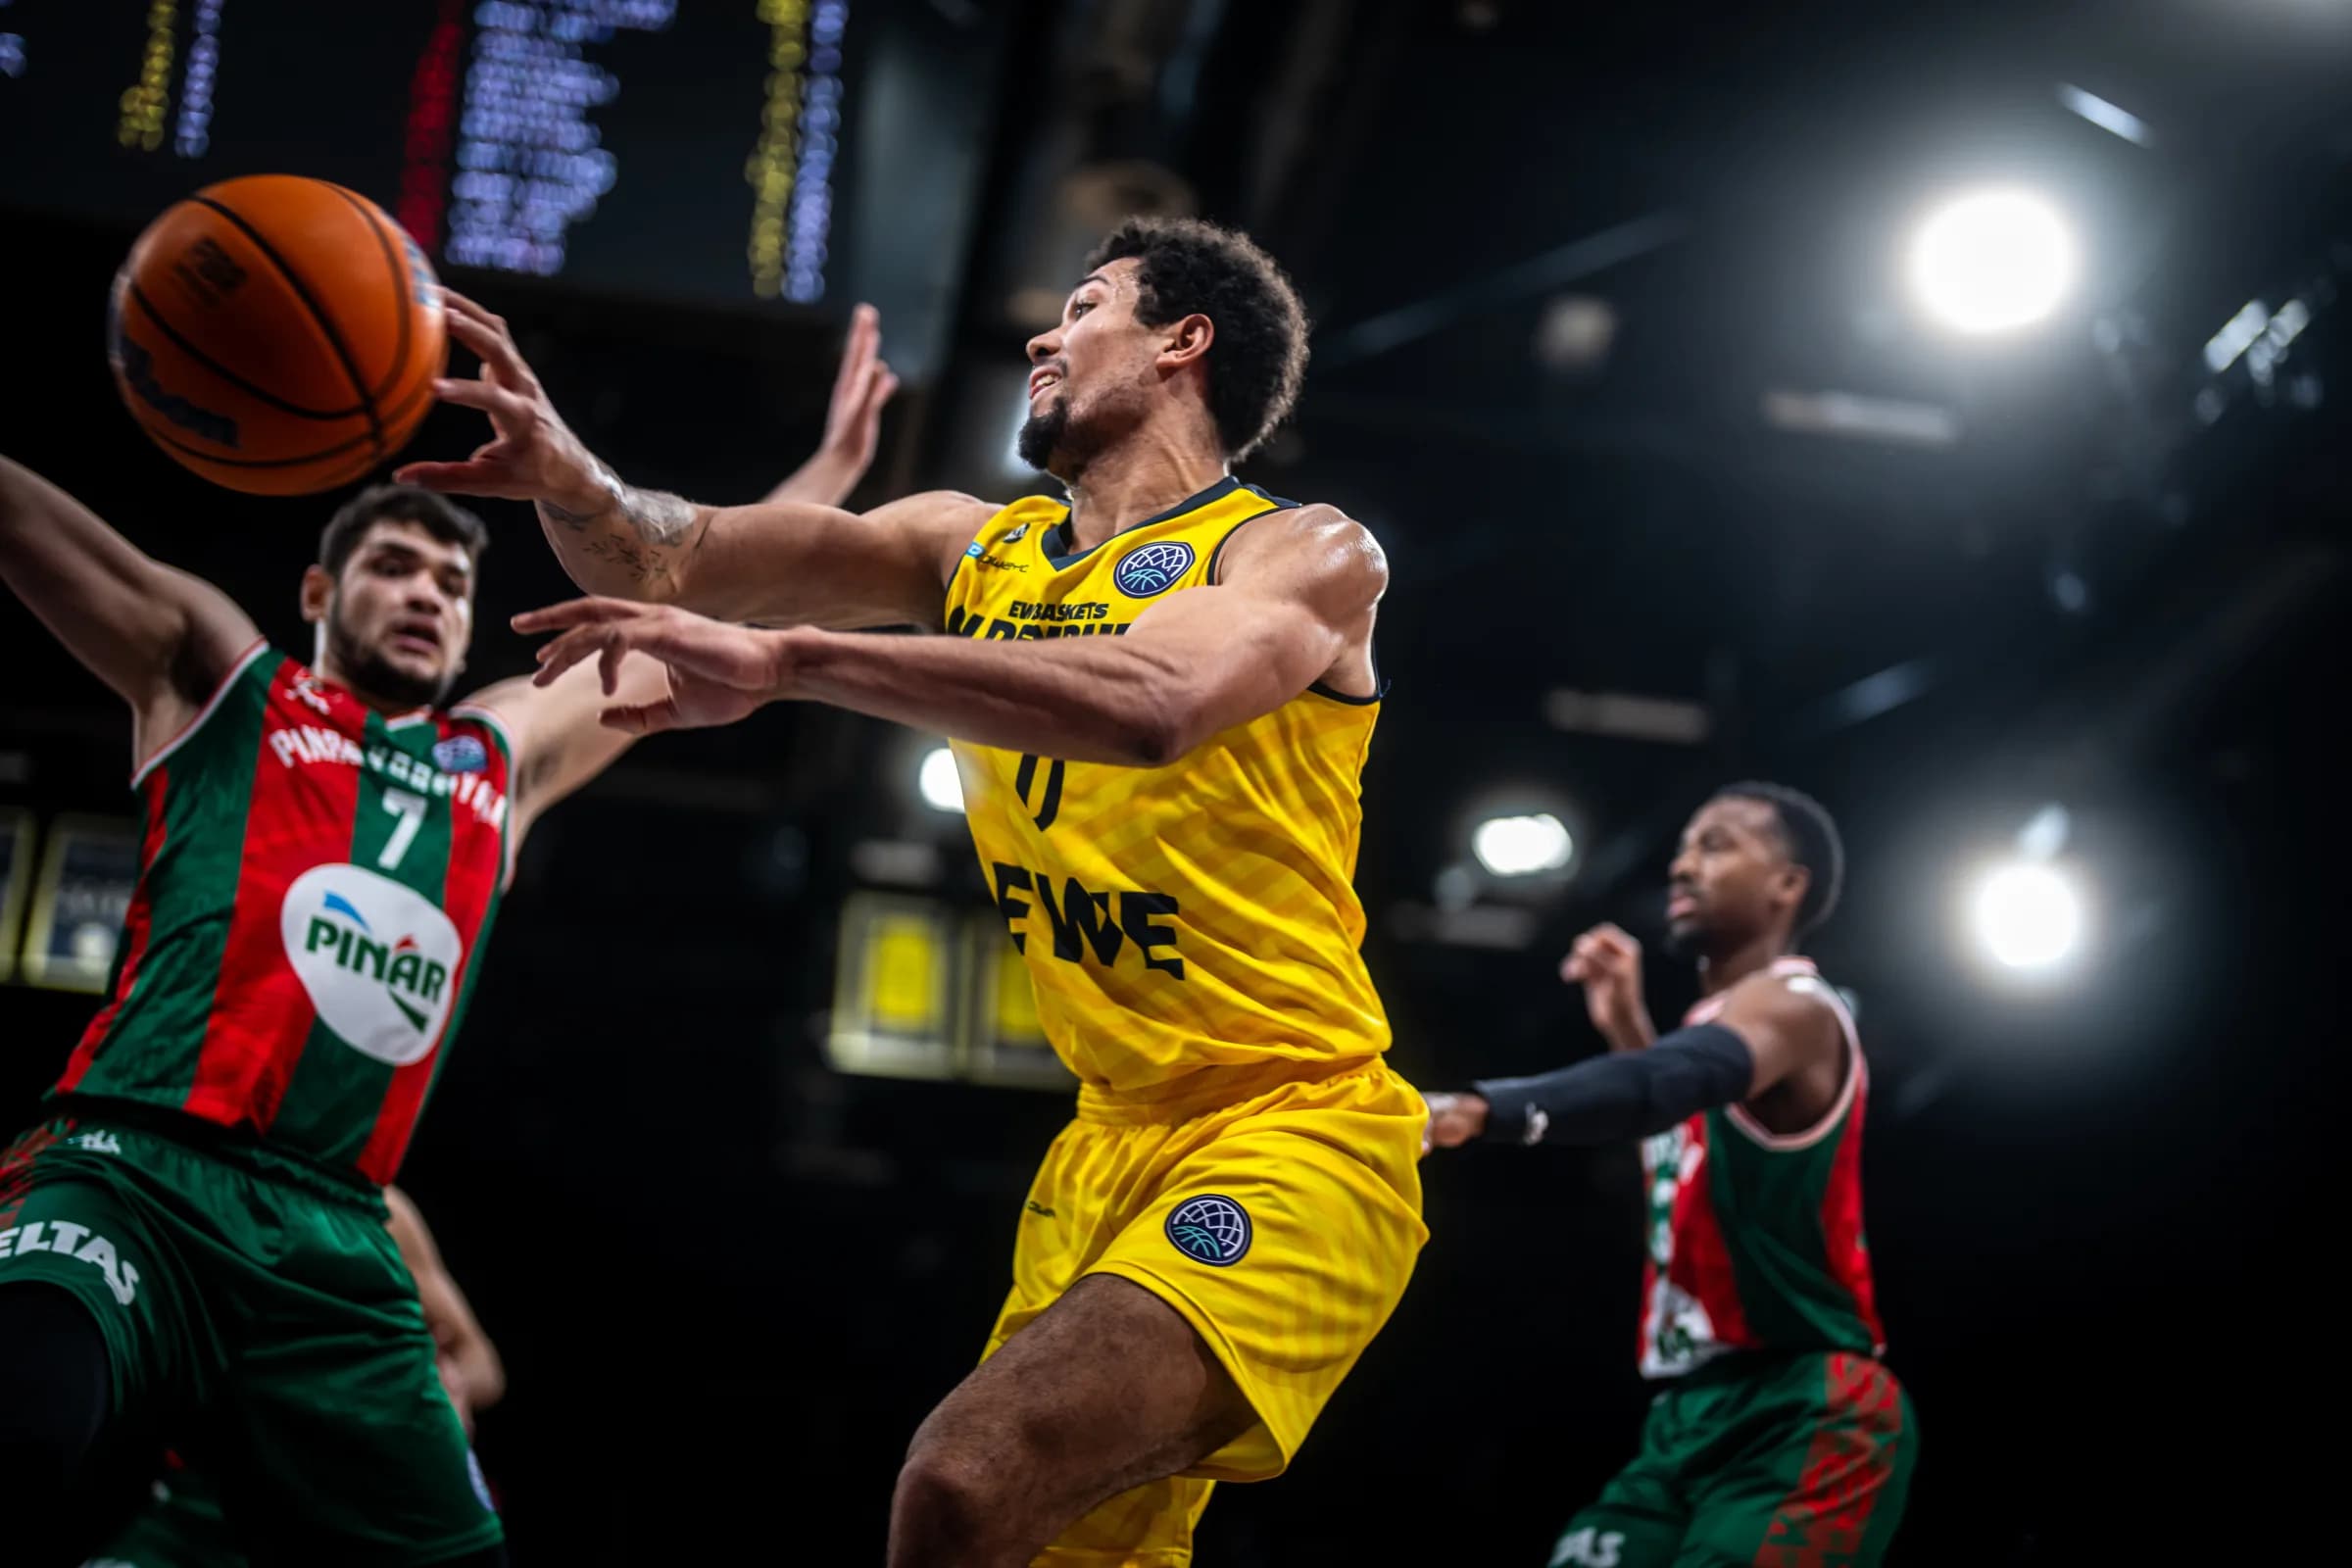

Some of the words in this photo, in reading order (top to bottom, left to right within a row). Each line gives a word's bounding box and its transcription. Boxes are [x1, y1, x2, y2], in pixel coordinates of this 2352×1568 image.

[379, 787, 427, 869] 7
[306, 914, 447, 1004] PINAR
[992, 861, 1185, 981] EWE
